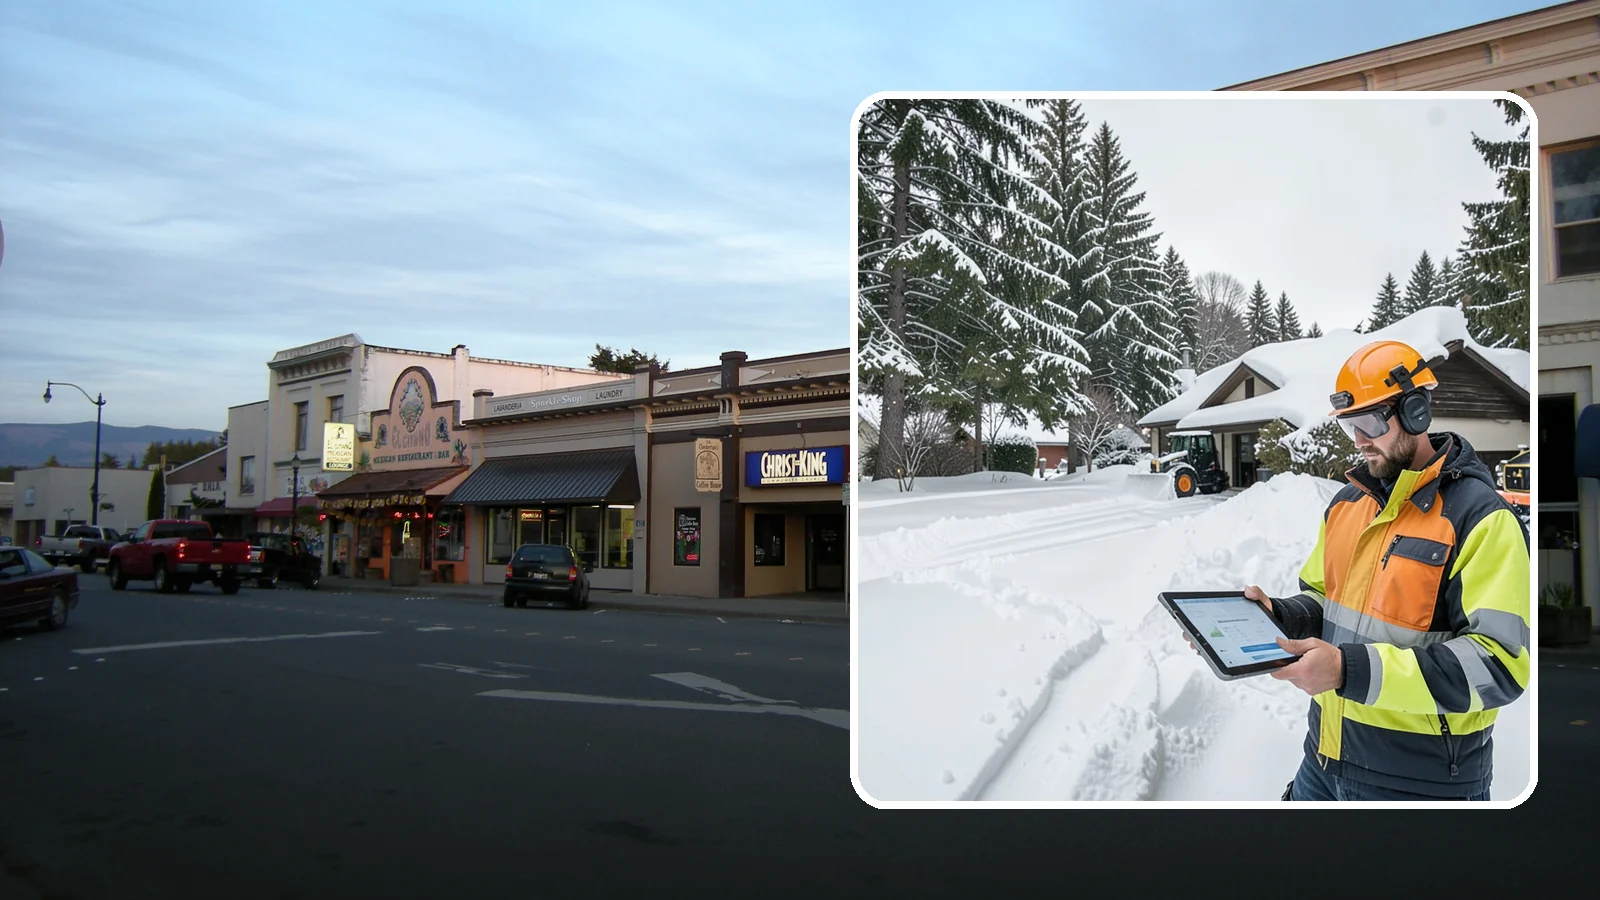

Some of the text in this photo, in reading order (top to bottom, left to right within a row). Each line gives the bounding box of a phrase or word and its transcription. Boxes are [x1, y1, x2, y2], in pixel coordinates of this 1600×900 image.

[493, 389, 624, 412] LAVANDERIA Sparkle Shop LAUNDRY
[373, 455, 396, 464] MEXICAN
[397, 451, 433, 462] RESTAURANT
[437, 450, 450, 459] BAR
[761, 450, 827, 478] CHRIST KING
